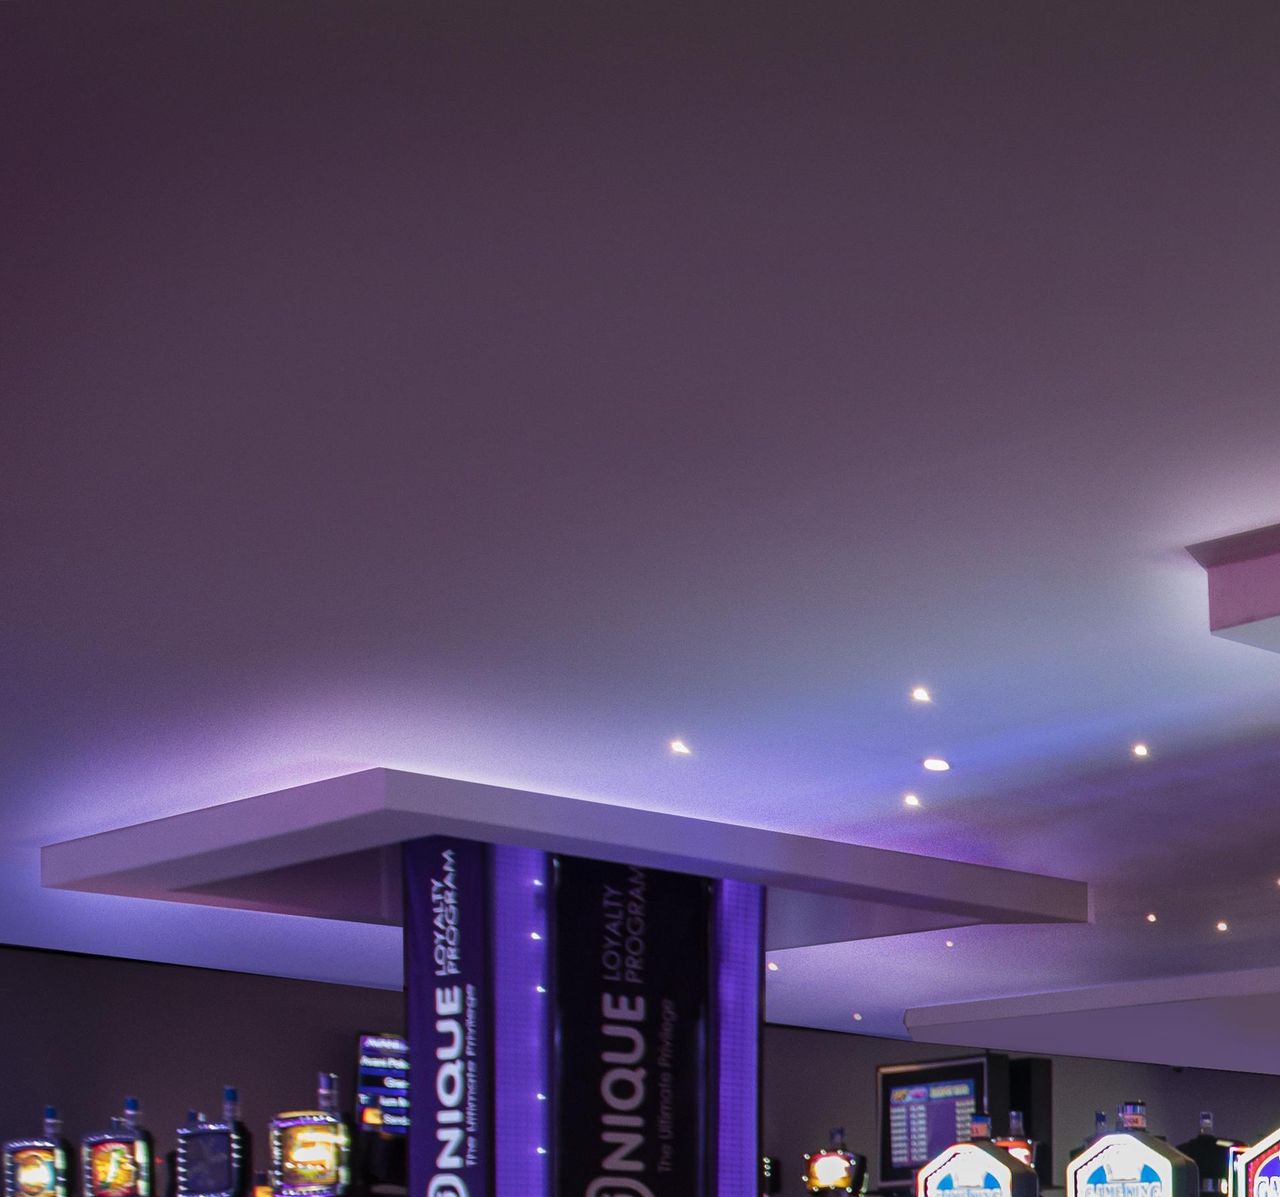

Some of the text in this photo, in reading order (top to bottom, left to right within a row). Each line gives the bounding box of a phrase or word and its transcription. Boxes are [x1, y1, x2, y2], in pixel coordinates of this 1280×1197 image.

[431, 877, 451, 977] LOYALTY
[441, 848, 462, 976] PROGRAM
[602, 884, 624, 981] LOYALTY
[625, 866, 647, 984] PROGRAM
[658, 998, 677, 1174] The Ultimate Privilege
